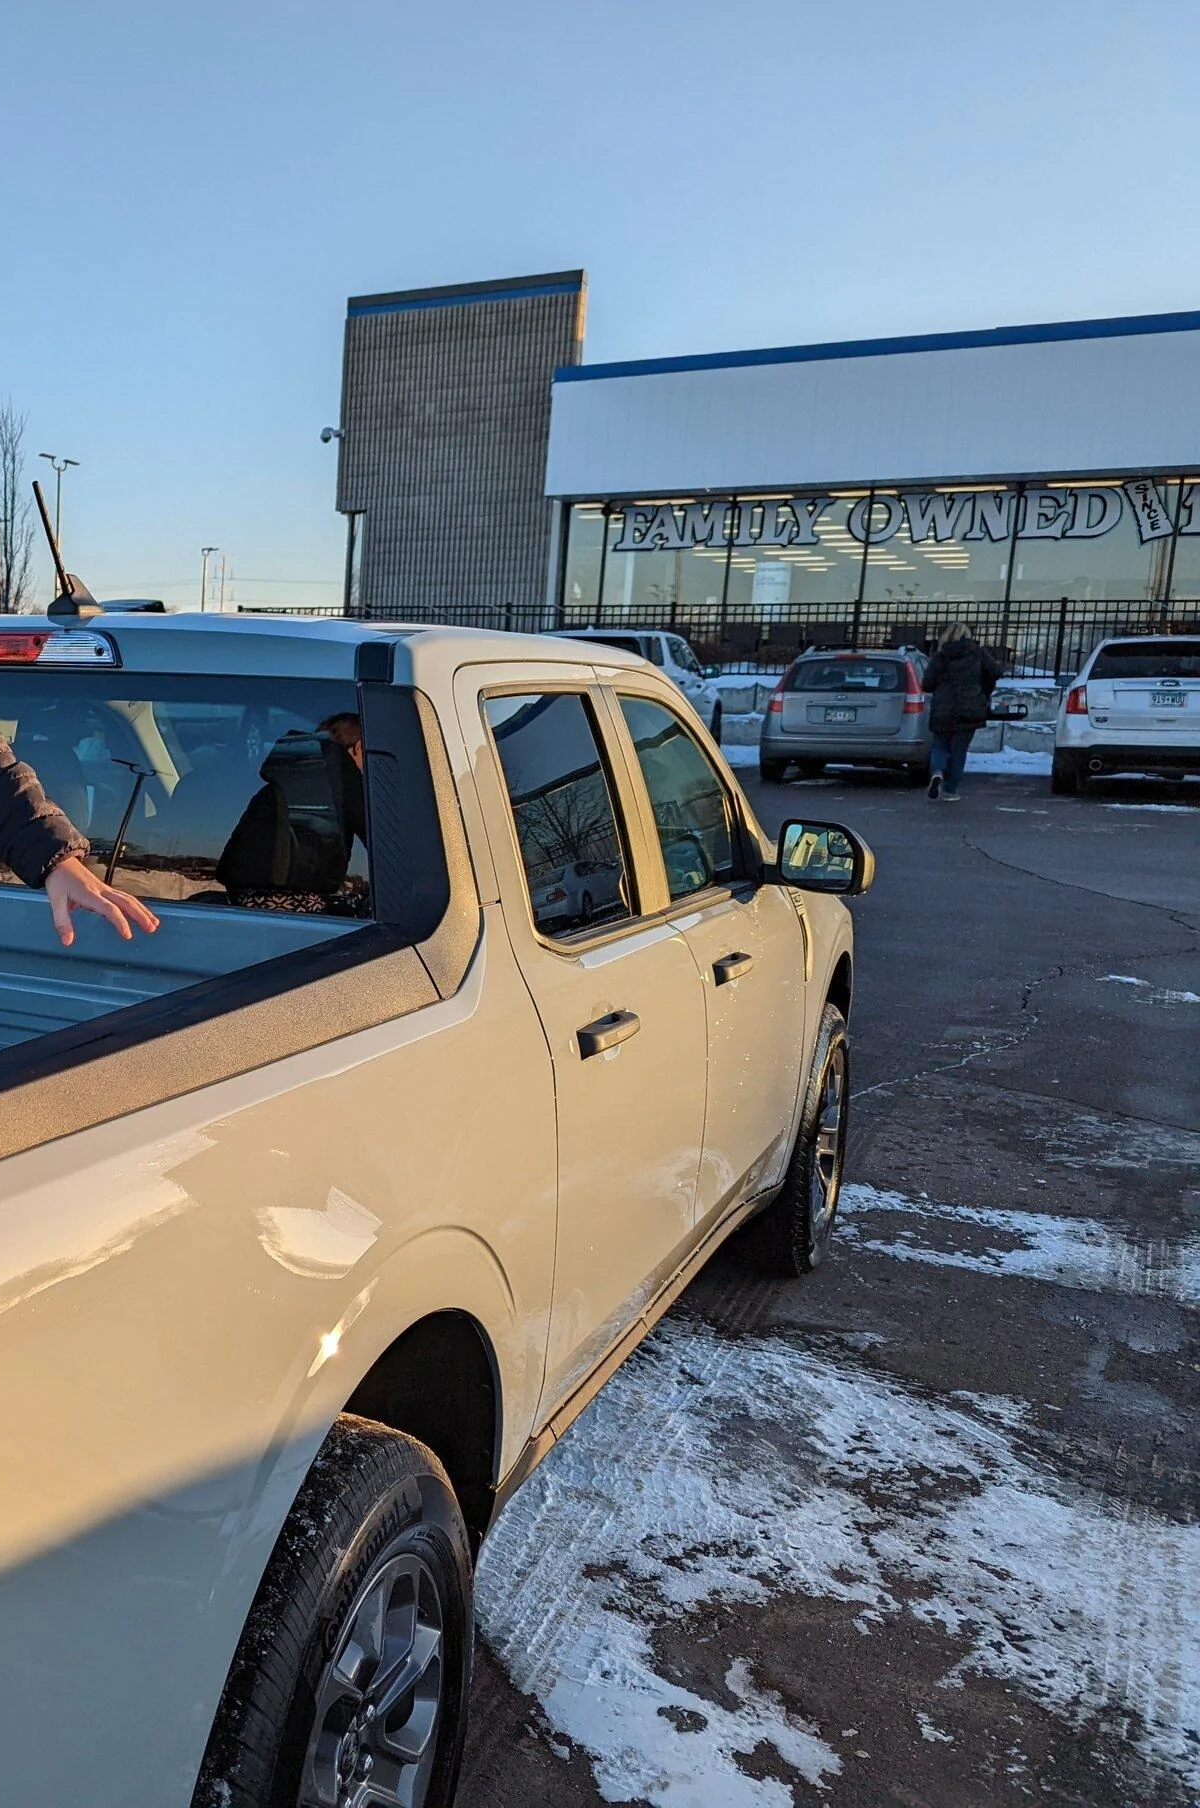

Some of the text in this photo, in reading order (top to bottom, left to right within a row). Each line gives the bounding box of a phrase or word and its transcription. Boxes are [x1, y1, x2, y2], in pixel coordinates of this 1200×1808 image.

[612, 498, 838, 552] FAMILY
[847, 487, 1124, 544] OWNED
[1134, 483, 1161, 532] SINCE
